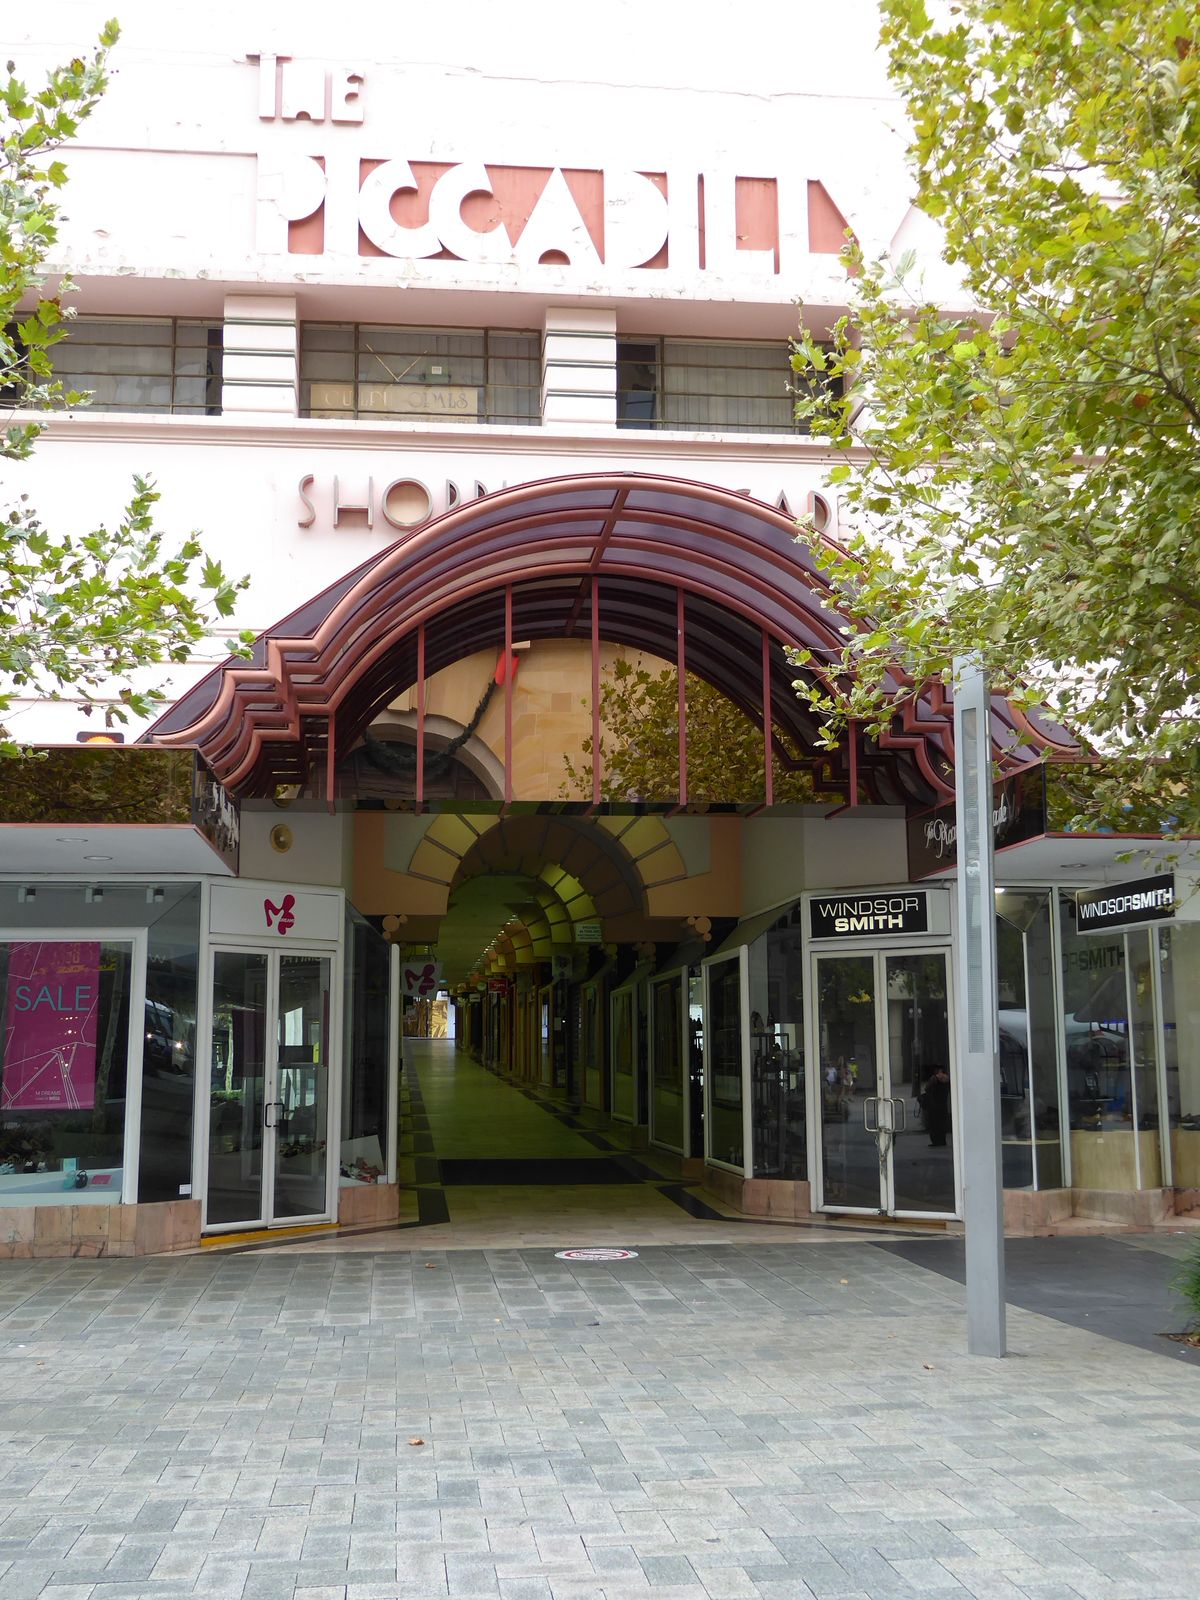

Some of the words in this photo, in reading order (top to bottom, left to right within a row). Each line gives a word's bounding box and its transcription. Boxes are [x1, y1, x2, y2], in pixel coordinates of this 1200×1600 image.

[819, 898, 919, 918] WINDSOR
[834, 914, 903, 932] SMITH
[14, 985, 92, 1012] SALE
